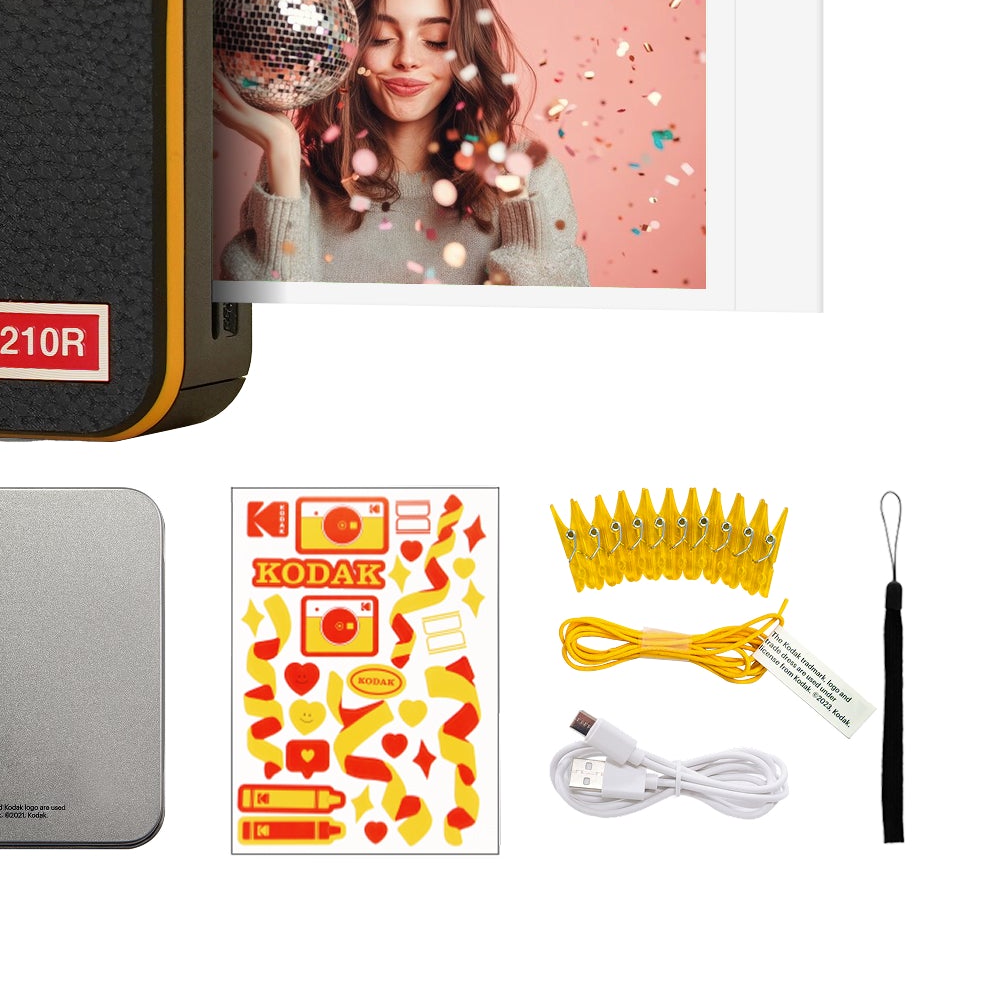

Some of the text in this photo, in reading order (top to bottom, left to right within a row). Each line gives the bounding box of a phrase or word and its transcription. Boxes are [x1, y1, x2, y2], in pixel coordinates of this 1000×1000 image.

[255, 561, 382, 586] KODAK
[759, 645, 780, 665] license
[780, 663, 794, 677] from
[765, 638, 837, 702] trade dress are used under
[783, 641, 801, 659] Kodak
[826, 680, 840, 694] logo
[840, 690, 851, 702] and
[357, 676, 395, 687] KODAK
[25, 804, 39, 812] logo
